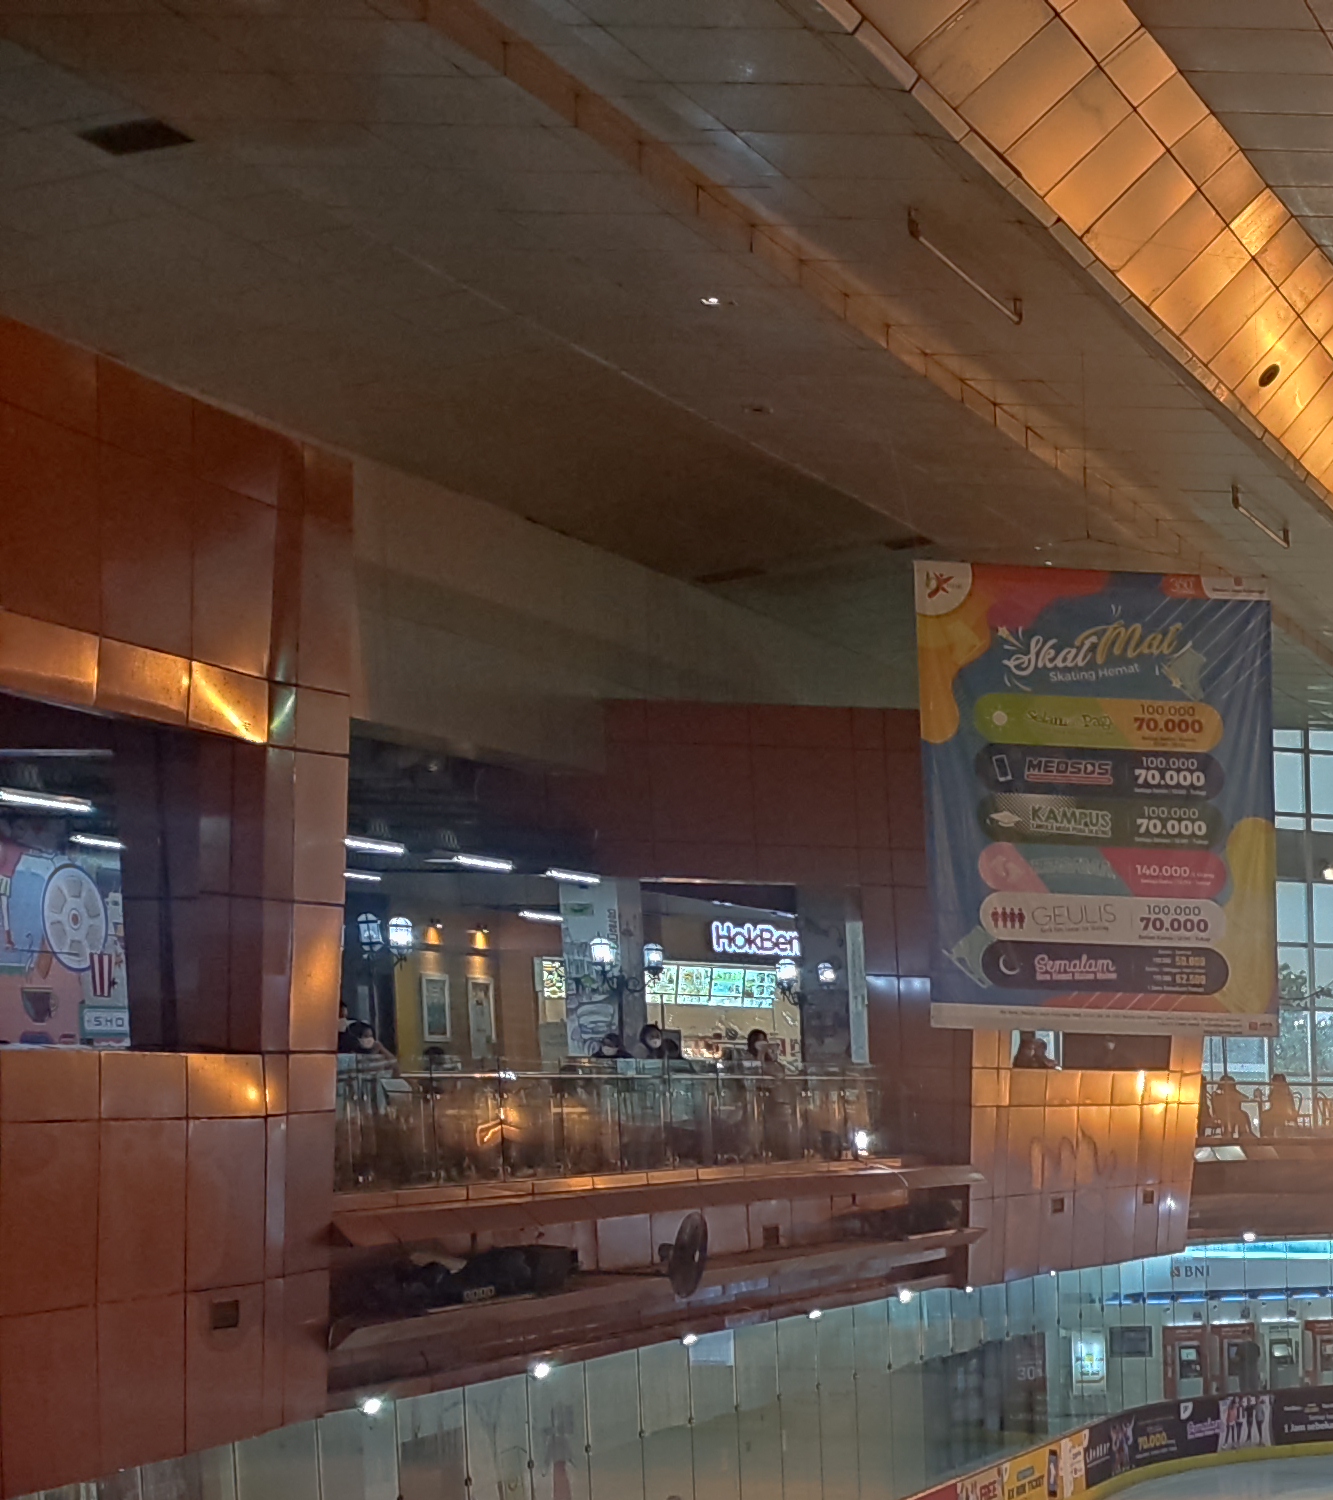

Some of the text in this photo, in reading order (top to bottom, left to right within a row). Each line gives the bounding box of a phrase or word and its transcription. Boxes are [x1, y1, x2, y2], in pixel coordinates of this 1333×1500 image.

[1049, 663, 1140, 683] Skating Hemat
[1133, 717, 1204, 734] 70.000
[1027, 758, 1112, 776] MEDSOS
[1142, 757, 1198, 770] 100.000
[1134, 769, 1206, 786] 70.000
[1031, 805, 1111, 829] KAMPUS
[1143, 806, 1199, 819] 100.000
[1136, 818, 1207, 836] 70.000
[1135, 864, 1190, 877] 140.000
[1031, 903, 1116, 926] GEULIS
[1146, 904, 1201, 917] 100.000
[1139, 917, 1209, 933] 70.000
[1034, 954, 1116, 973] Semalam
[1184, 1265, 1210, 1278] BNI
